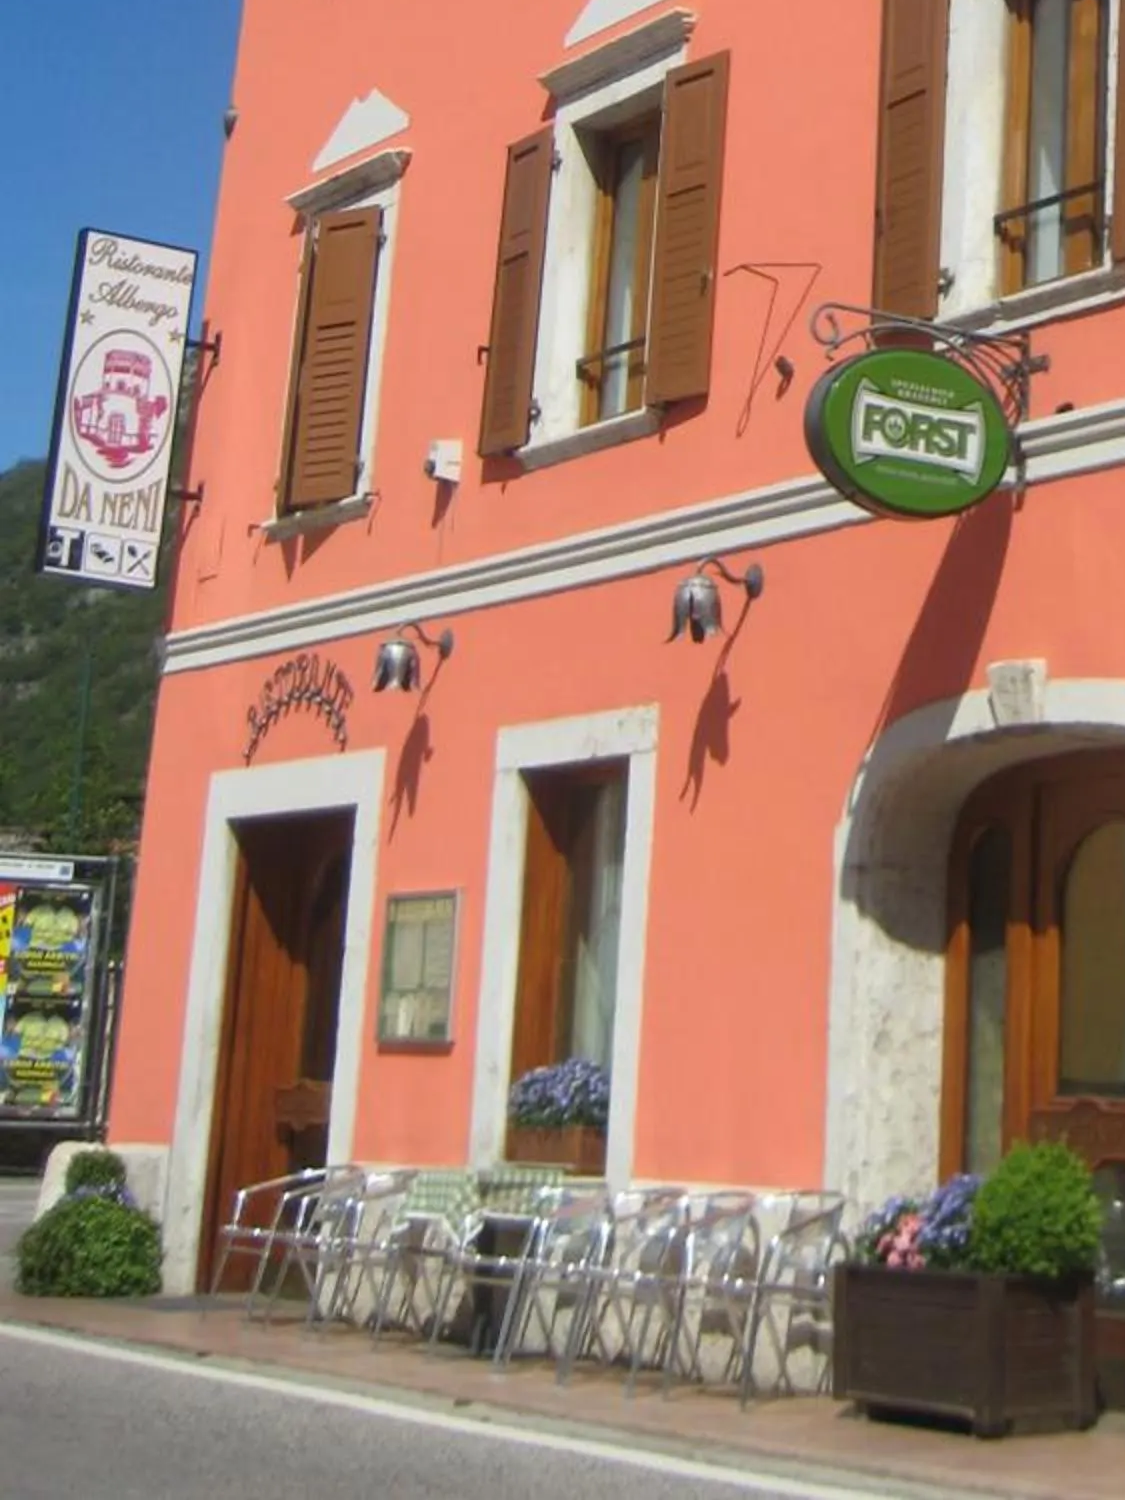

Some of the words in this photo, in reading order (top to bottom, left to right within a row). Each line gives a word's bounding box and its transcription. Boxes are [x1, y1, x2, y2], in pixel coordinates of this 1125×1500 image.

[88, 237, 193, 286] Ristorante
[88, 278, 179, 327] Albergo
[861, 402, 977, 460] FORST
[57, 461, 93, 523] DA
[100, 477, 164, 534] NENI
